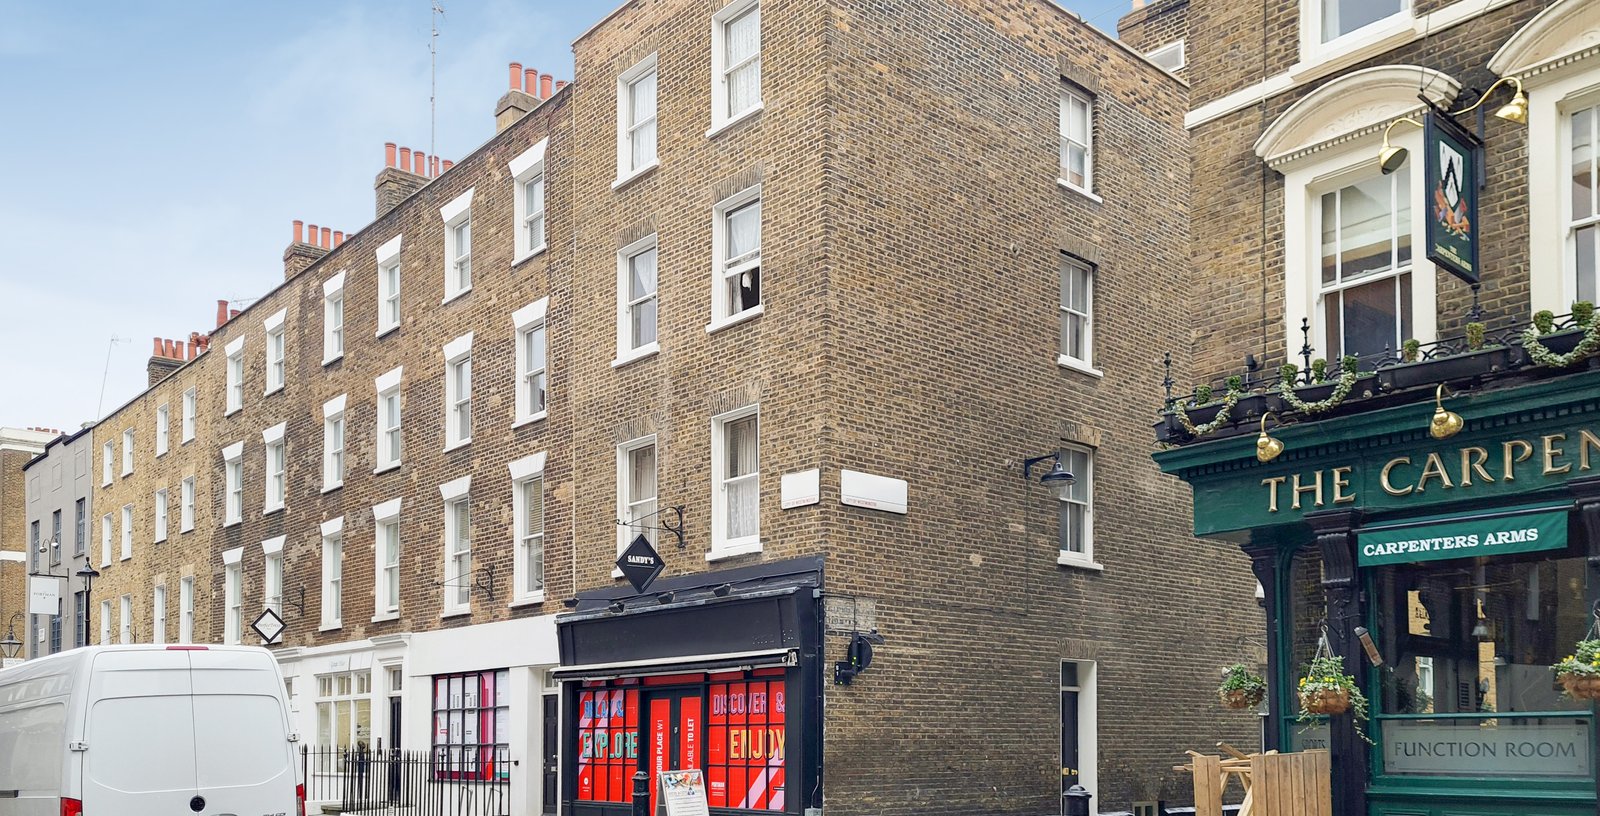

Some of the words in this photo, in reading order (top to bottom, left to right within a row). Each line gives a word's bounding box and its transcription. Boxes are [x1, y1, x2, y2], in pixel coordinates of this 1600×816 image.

[1261, 465, 1356, 513] THE
[1363, 534, 1479, 557] CARPENTERS
[1484, 528, 1539, 546] ARMS
[627, 555, 654, 565] SANDY'S
[657, 719, 663, 730] W1
[687, 732, 694, 742] TO
[1395, 742, 1496, 757] FUNCTION
[1505, 742, 1576, 758] ROOM
